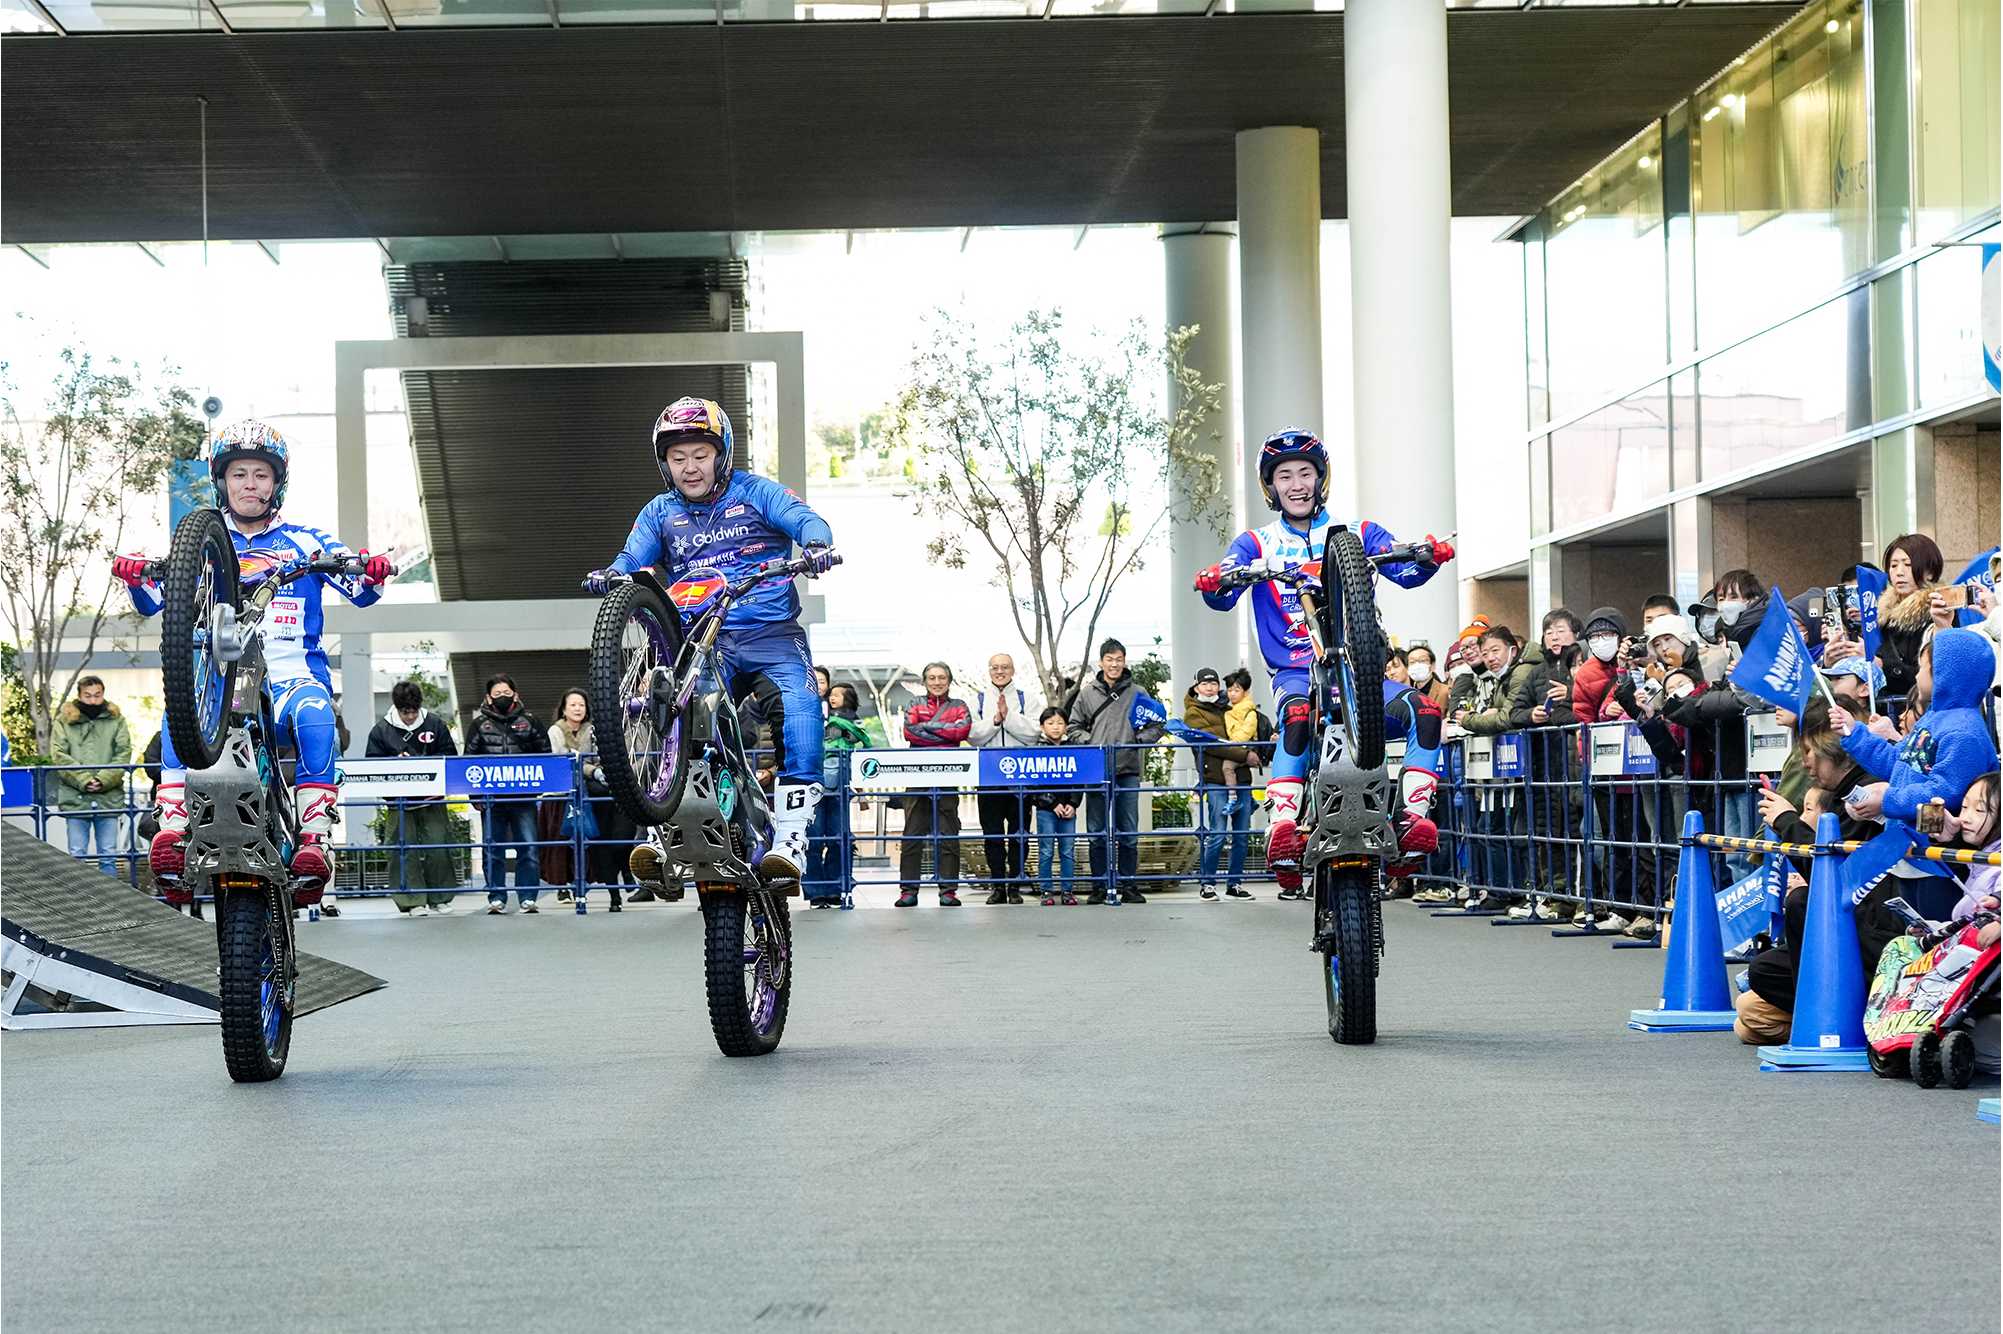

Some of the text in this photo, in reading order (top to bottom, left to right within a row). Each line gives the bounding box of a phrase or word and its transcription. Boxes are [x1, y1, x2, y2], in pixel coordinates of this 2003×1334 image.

[692, 523, 749, 547] Goldwin
[697, 551, 736, 567] YAMAHA
[273, 602, 298, 610] MOTUL
[903, 765, 920, 773] TRIAL
[1016, 756, 1078, 773] YAMAHA
[343, 775, 368, 783] YAMAHA
[370, 775, 385, 783] TRIAL
[387, 774, 409, 782] SUPER
[483, 765, 545, 782] YAMAHA
